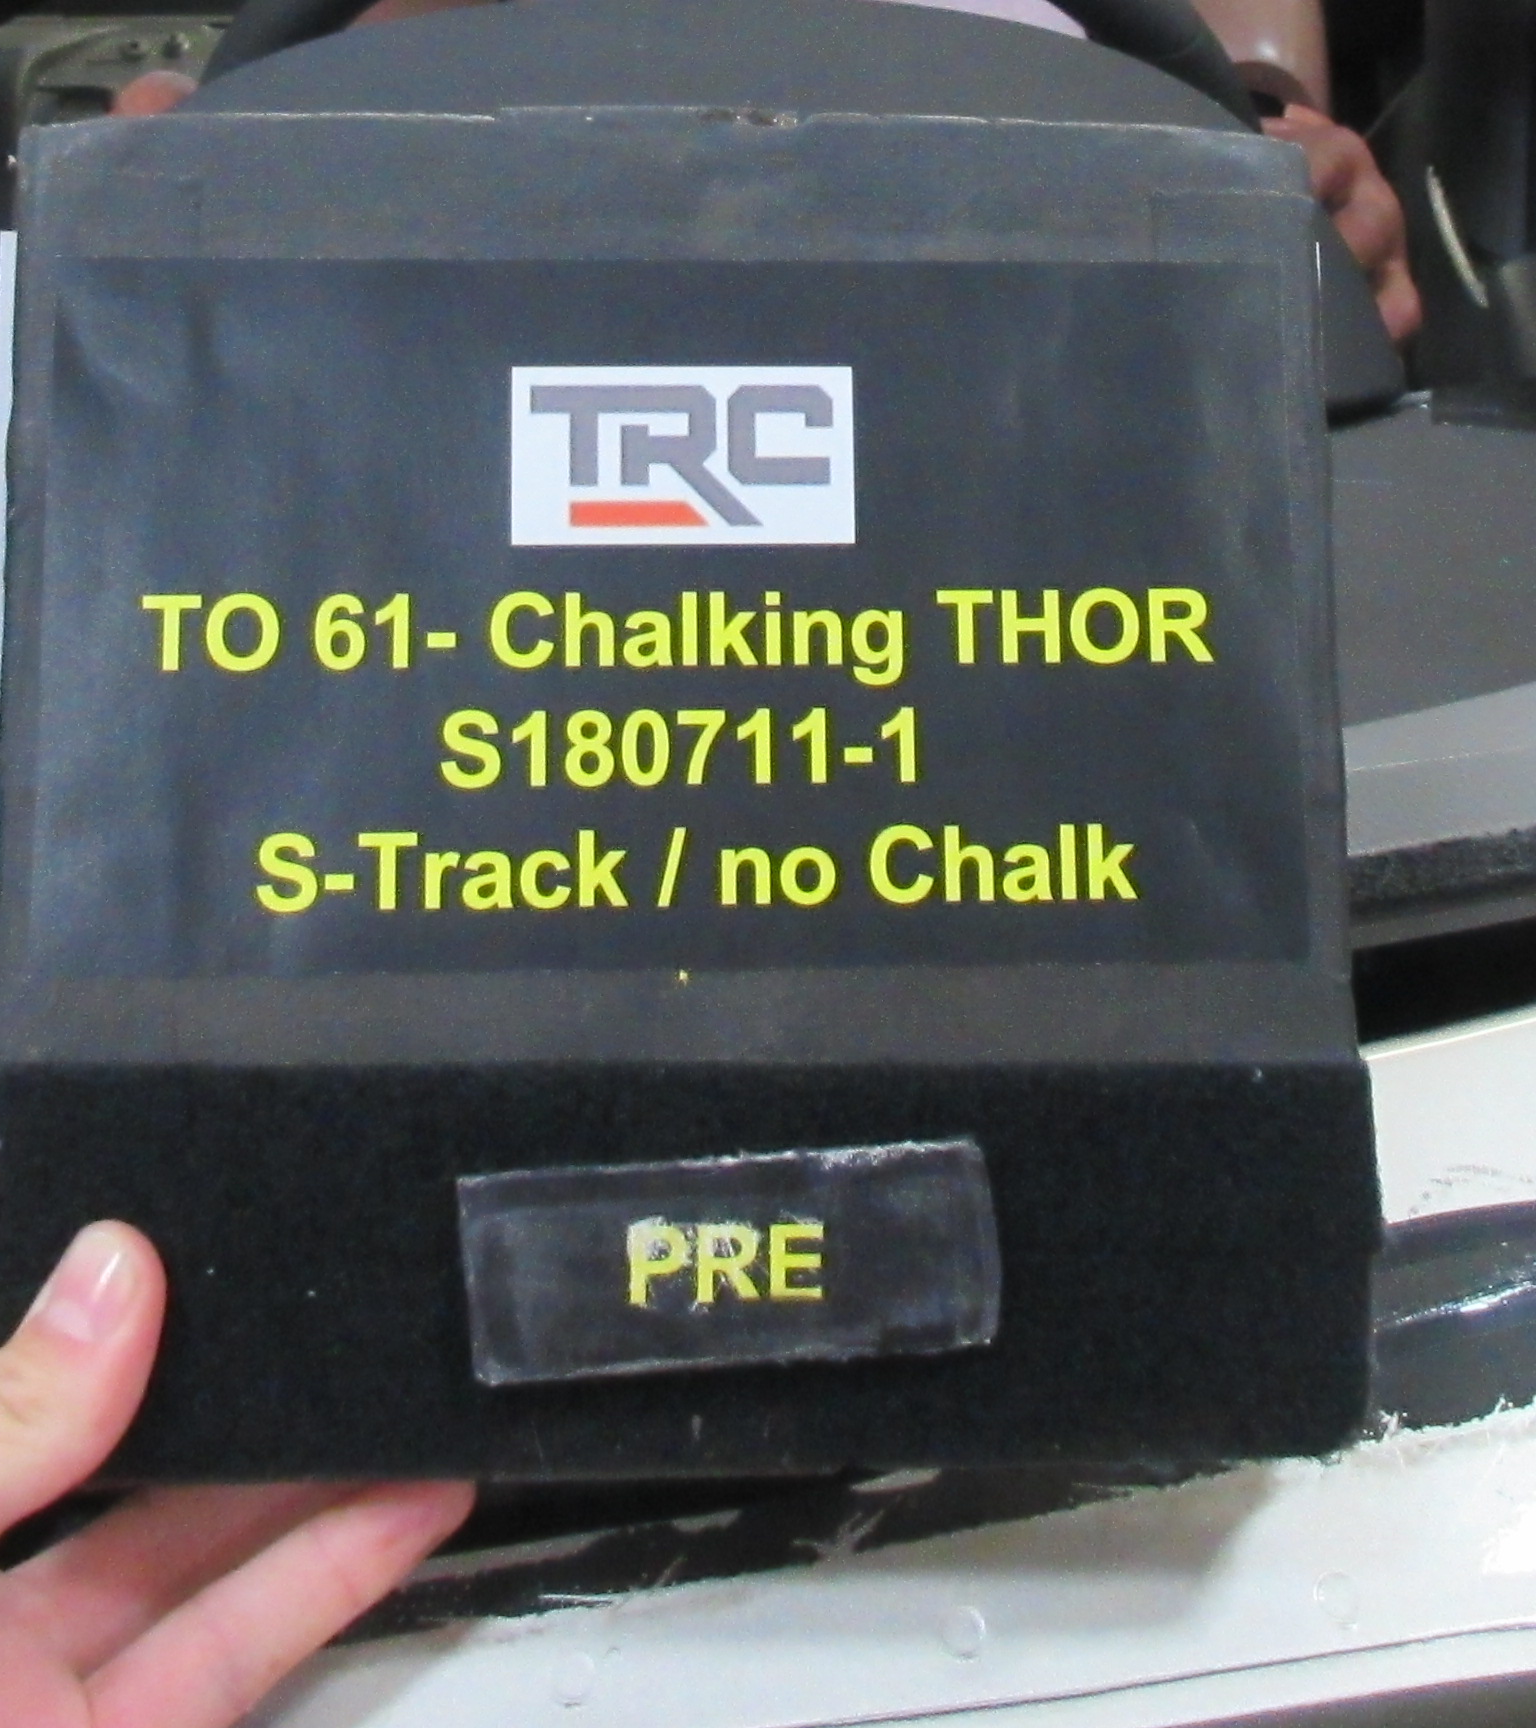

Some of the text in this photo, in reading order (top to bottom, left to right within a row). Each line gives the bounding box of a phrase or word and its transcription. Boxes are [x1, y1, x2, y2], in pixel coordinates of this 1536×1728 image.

[530, 385, 834, 527] TRC
[139, 586, 1214, 688] TO 61- Chalking THOR
[439, 707, 917, 792] S180711-1
[253, 823, 1137, 914] S-Track / no Chalk
[625, 1221, 827, 1306] PRE
